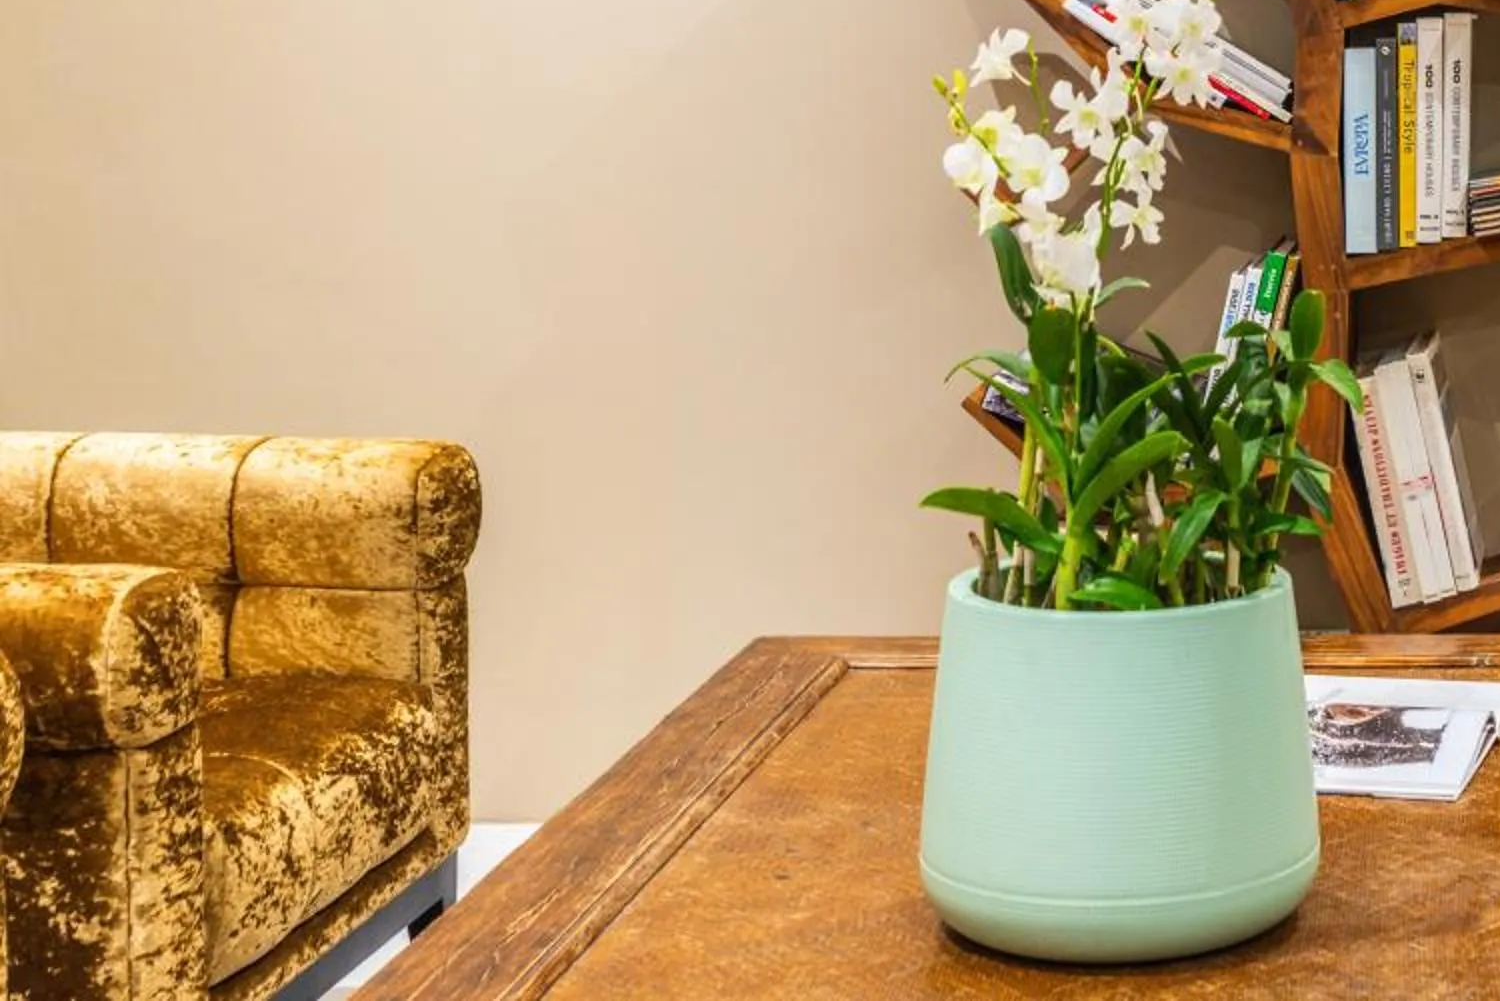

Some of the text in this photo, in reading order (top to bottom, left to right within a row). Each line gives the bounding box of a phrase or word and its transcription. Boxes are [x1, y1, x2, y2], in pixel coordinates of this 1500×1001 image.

[1425, 64, 1433, 88] 100
[1452, 59, 1461, 83] 100
[1401, 60, 1414, 155] Tropical Style
[1385, 512, 1398, 529] ET
